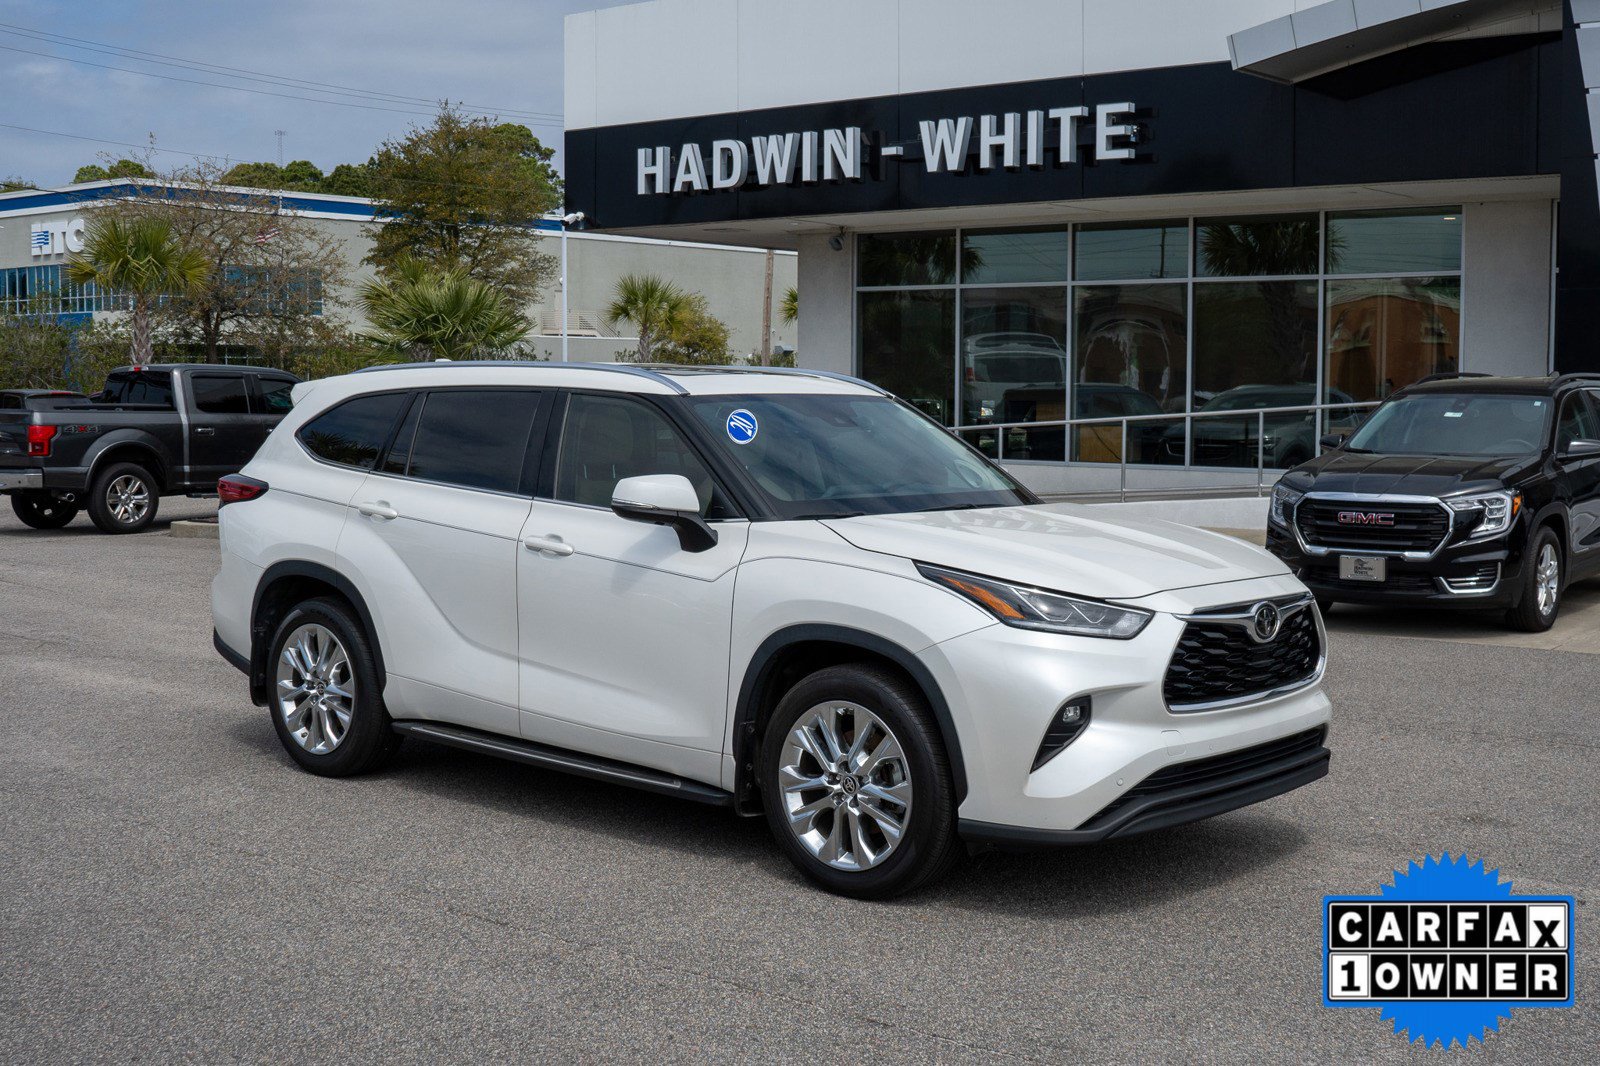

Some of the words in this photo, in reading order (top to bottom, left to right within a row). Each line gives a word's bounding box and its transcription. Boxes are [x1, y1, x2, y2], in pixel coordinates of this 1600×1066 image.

[637, 127, 861, 195] HADWIN
[919, 102, 1136, 172] WHITE
[1338, 512, 1394, 525] GMC
